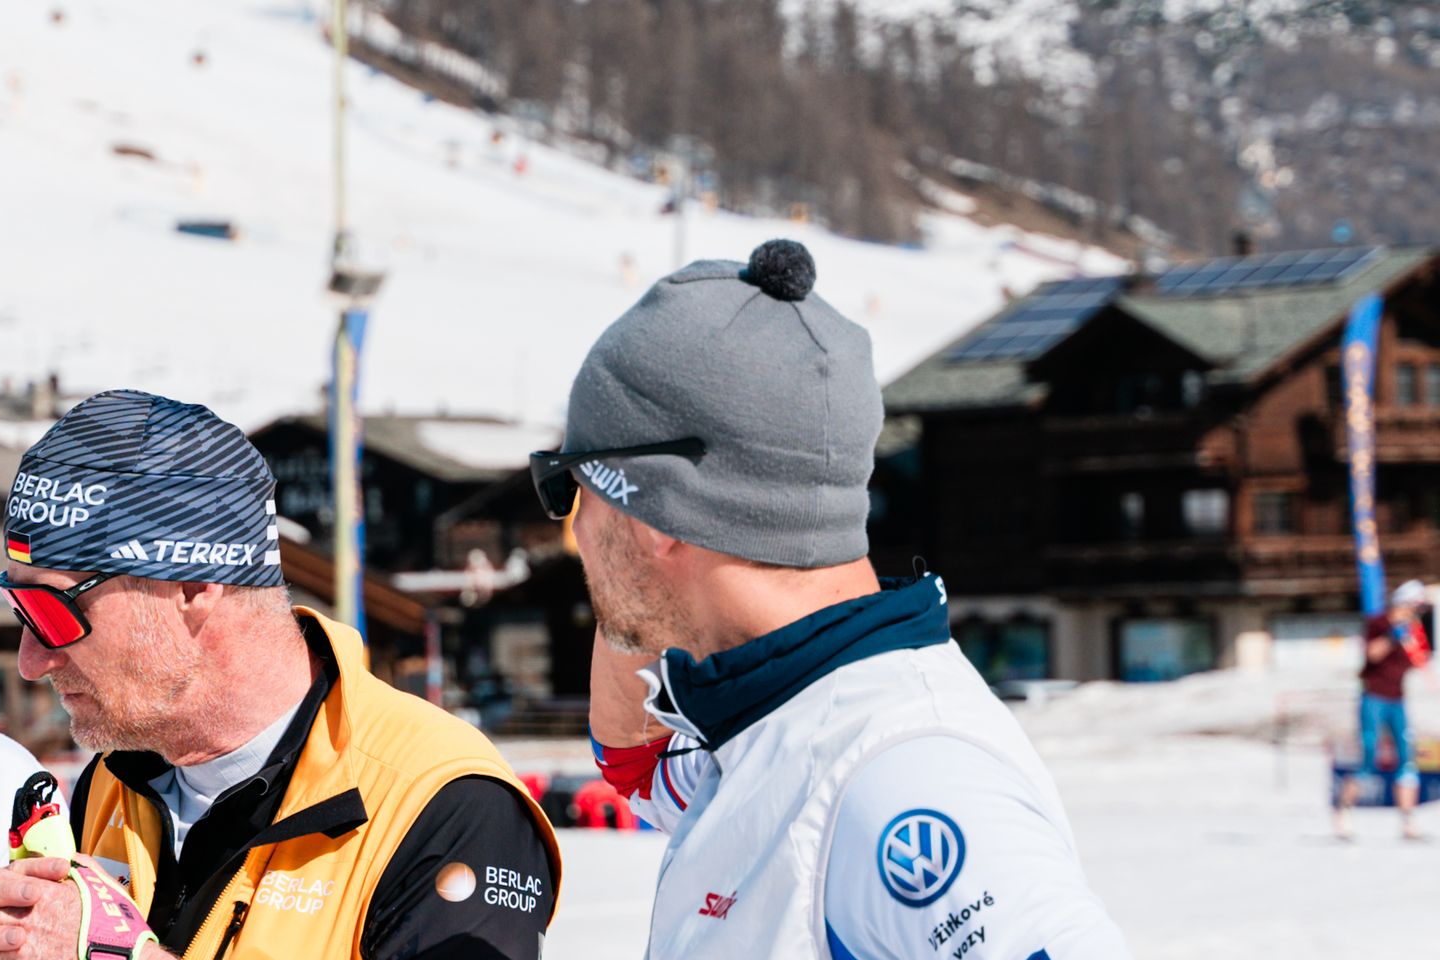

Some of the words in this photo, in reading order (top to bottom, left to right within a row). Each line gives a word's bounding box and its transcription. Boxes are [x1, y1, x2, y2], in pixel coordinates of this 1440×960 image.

[13, 472, 107, 505] BERLAC
[9, 496, 90, 528] GROUP
[153, 540, 258, 566] TERREX
[260, 870, 335, 897] BERLAC
[486, 866, 542, 896] BERLAC
[86, 875, 131, 933] LEKI
[255, 887, 325, 915] GROUP
[484, 886, 537, 913] GROUP
[953, 926, 985, 960] vozy
